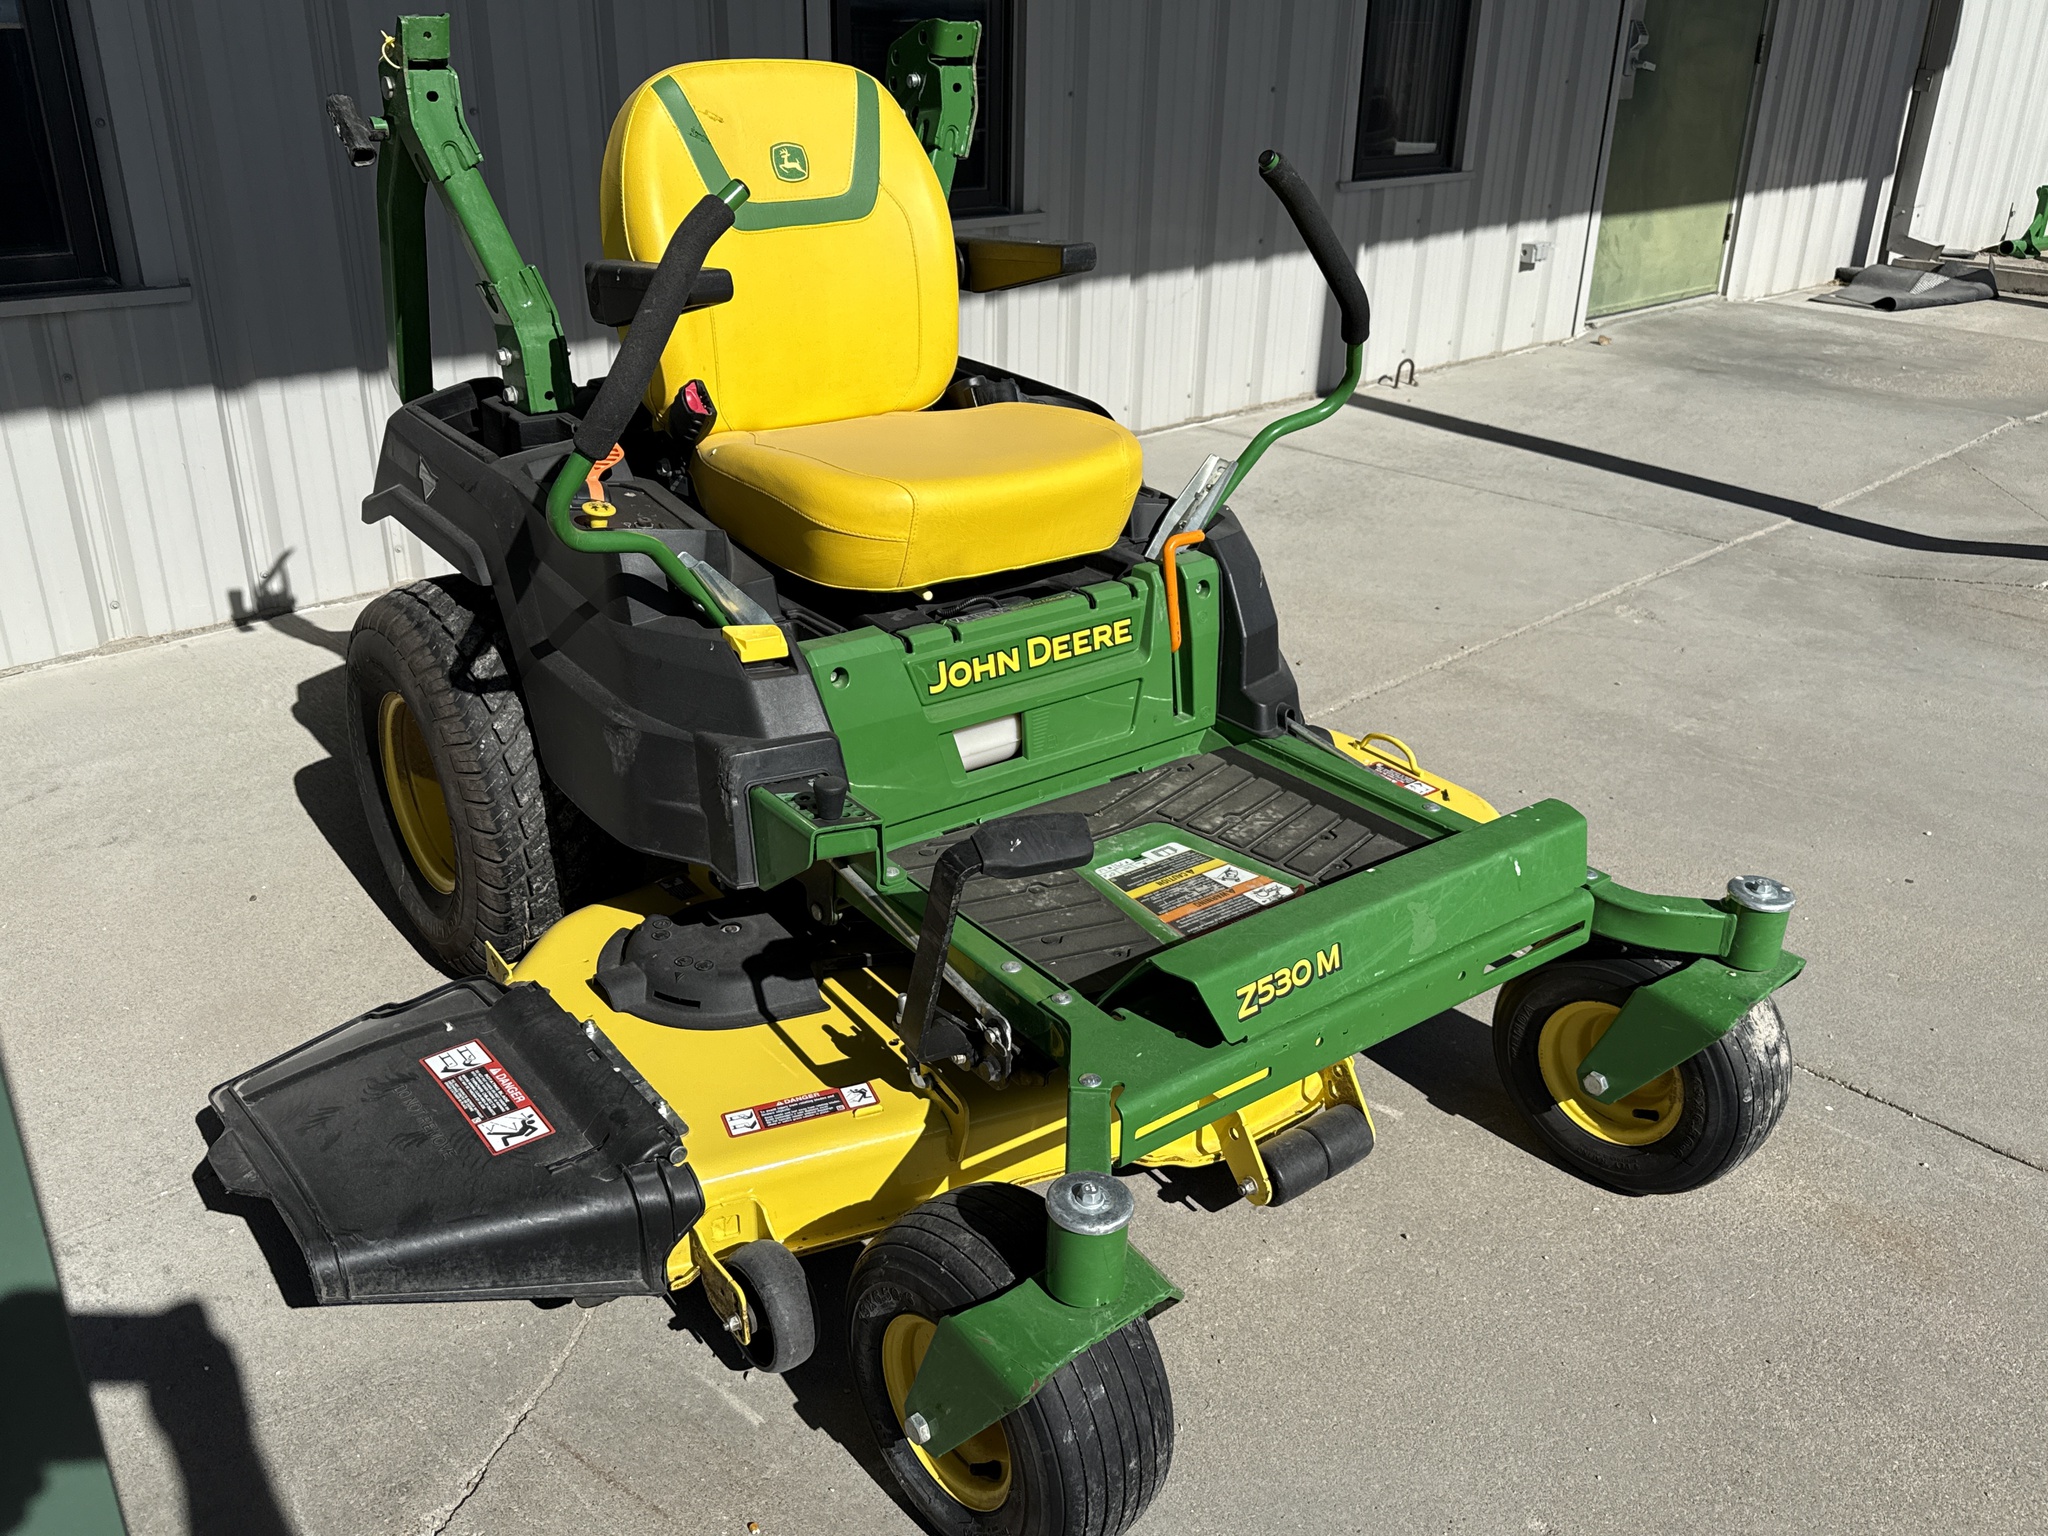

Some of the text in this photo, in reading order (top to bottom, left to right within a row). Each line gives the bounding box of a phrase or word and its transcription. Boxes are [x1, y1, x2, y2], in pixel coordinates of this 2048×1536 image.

[929, 617, 1133, 695] JOHN DEERE
[1155, 872, 1188, 886] CAUTION
[1193, 890, 1230, 907] WARNING
[1236, 942, 1342, 1023] Z530 M
[495, 1073, 526, 1103] DANGER
[784, 1092, 820, 1104] DANGER
[392, 1083, 458, 1160] DO NOT REMOVE
